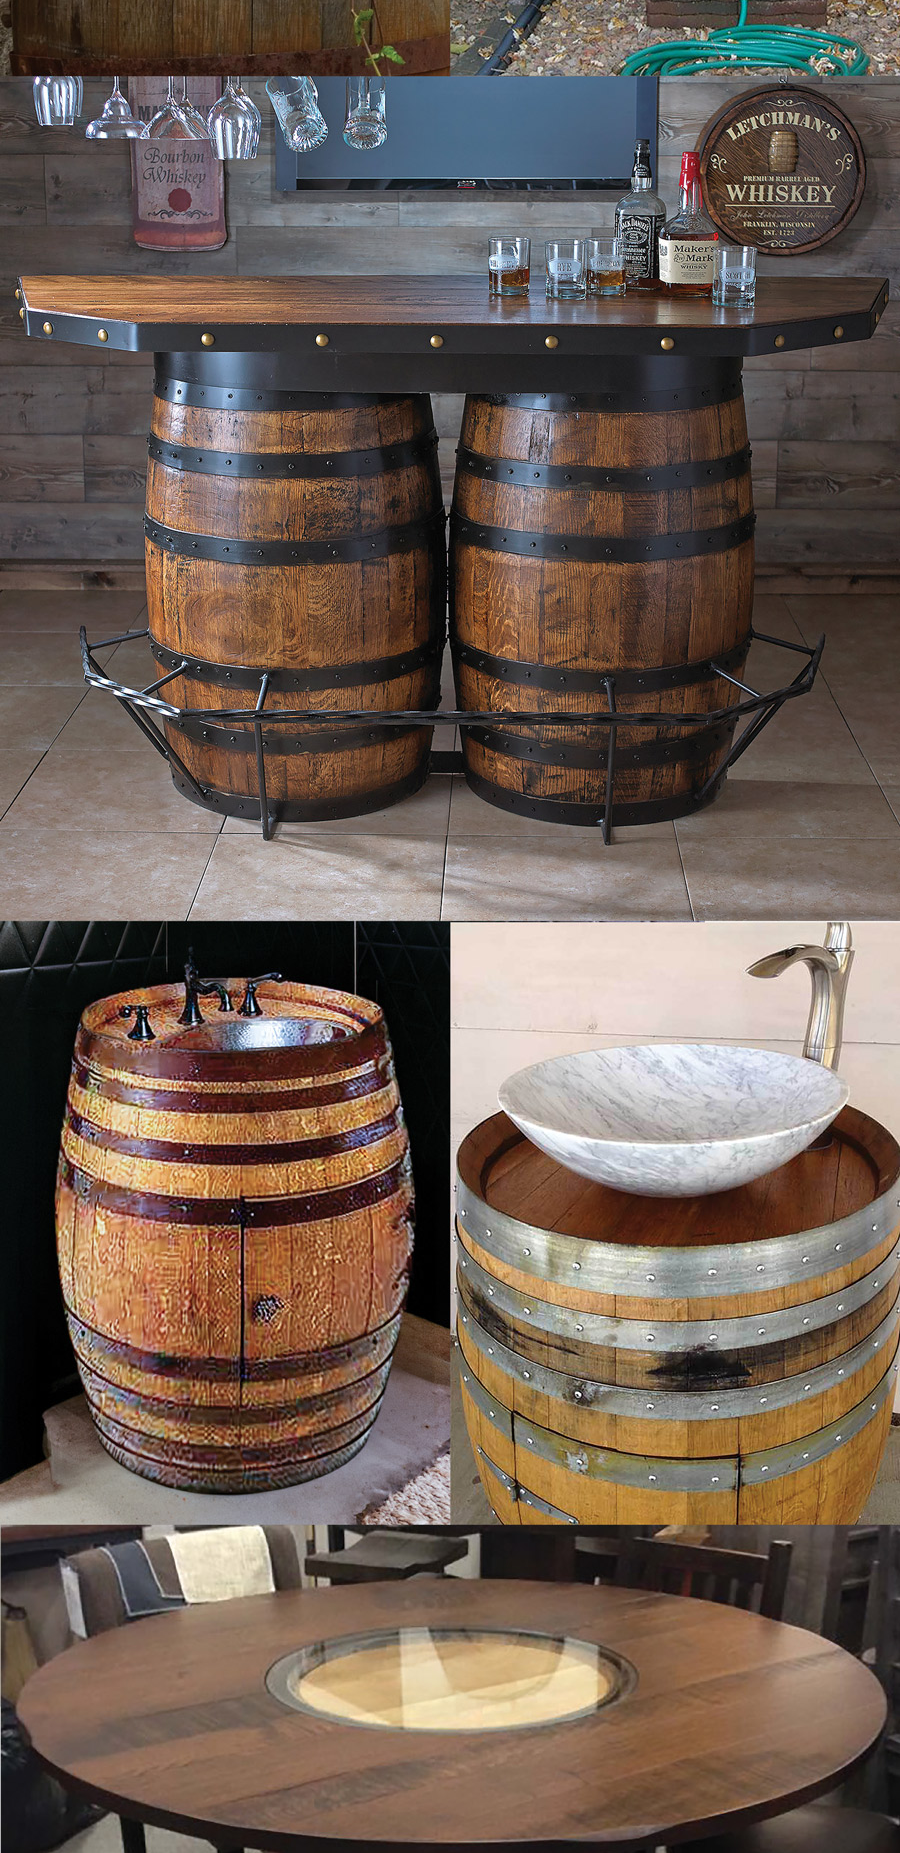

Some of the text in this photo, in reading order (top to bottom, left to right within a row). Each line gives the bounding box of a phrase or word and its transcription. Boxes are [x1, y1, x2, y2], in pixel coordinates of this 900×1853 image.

[726, 112, 841, 141] LETCHMAN'S
[144, 147, 204, 163] Bourbon
[143, 166, 206, 188] Whiskey
[726, 184, 836, 203] WHISKEY
[686, 254, 714, 262] Mark
